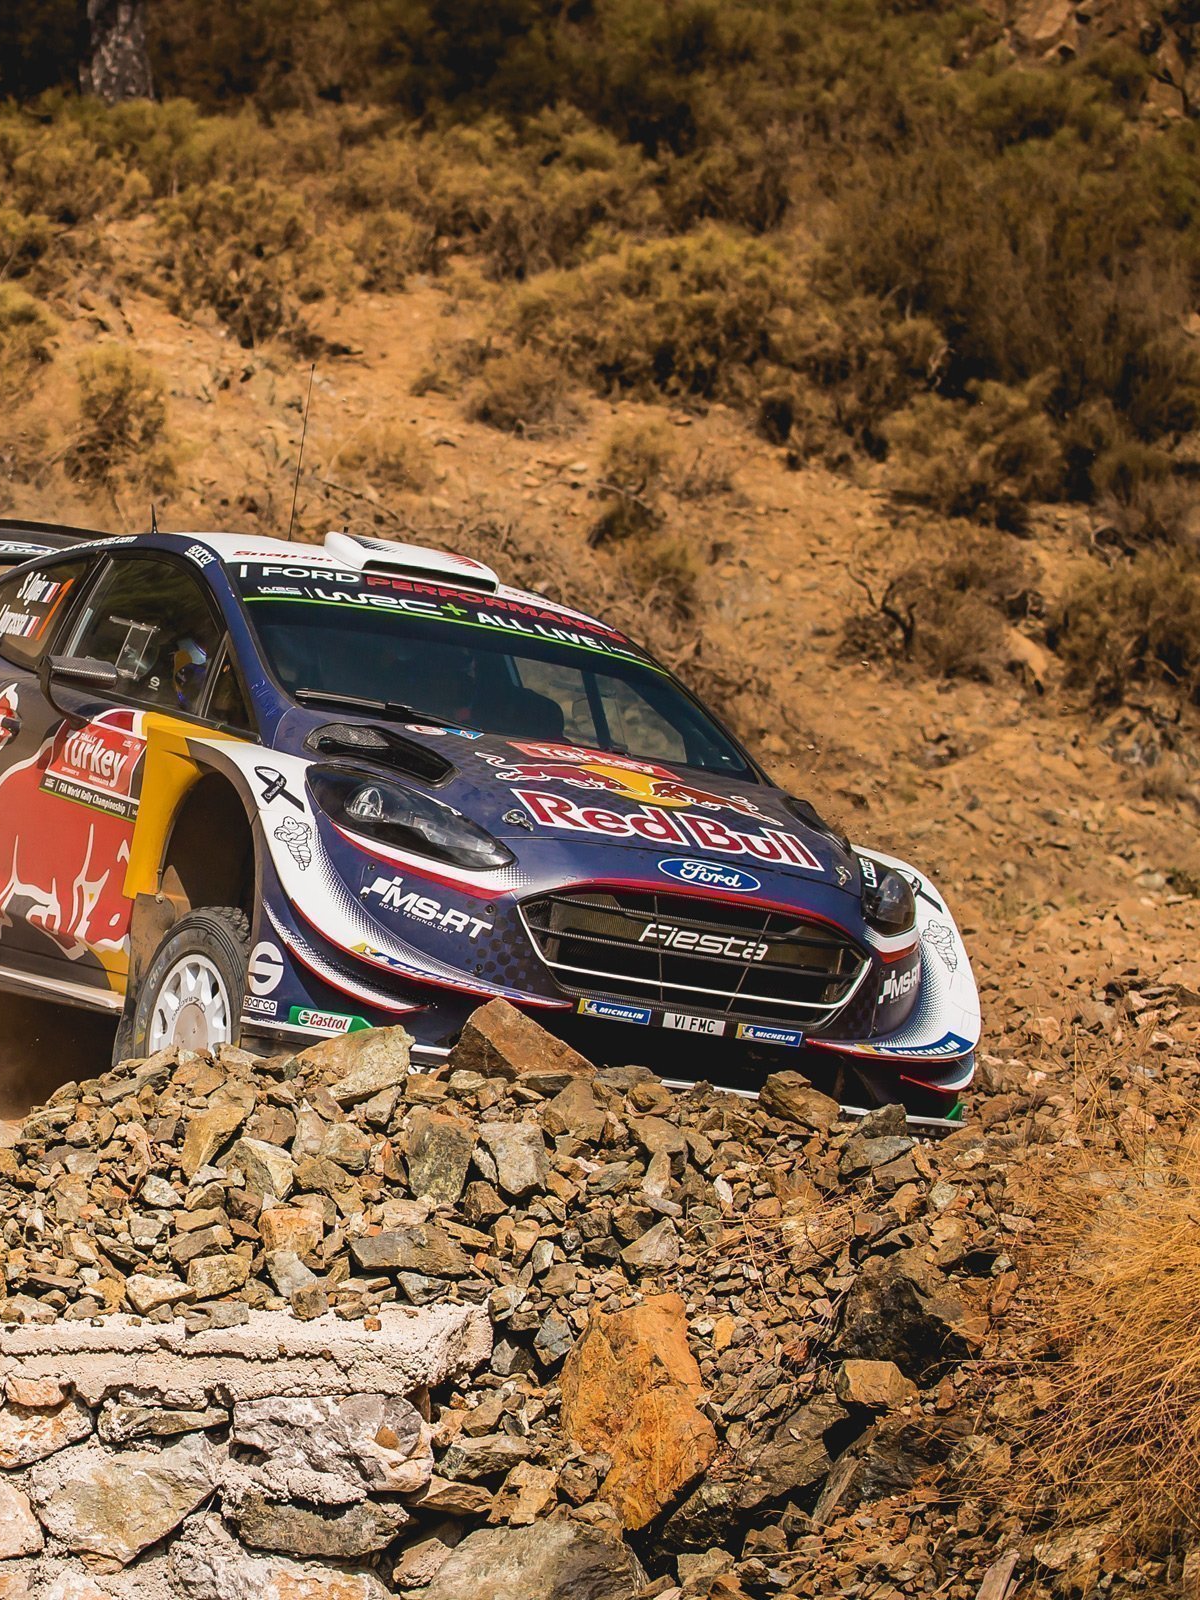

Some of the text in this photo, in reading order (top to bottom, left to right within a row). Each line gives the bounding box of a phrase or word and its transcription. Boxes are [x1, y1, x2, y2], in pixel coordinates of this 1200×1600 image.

[262, 566, 360, 583] FORD
[366, 576, 628, 645] PERFORMANCE
[476, 611, 534, 634] ALL
[534, 623, 603, 650] LIVE
[64, 731, 129, 788] Turkey
[67, 785, 81, 798] World
[92, 794, 127, 815] Championship
[510, 788, 825, 872] Red Bull
[679, 861, 743, 888] Ford
[378, 902, 454, 935] ROAD TECHNOLOGY
[381, 884, 494, 939] MS-RT
[638, 923, 769, 962] Fiesta
[243, 997, 277, 1011] sparco
[598, 1007, 645, 1019] MICHELIN
[308, 1012, 349, 1032] Castrol
[689, 1017, 716, 1034] FMC
[755, 1030, 796, 1042] MICHELIN
[896, 1040, 961, 1056] MICHELIN
